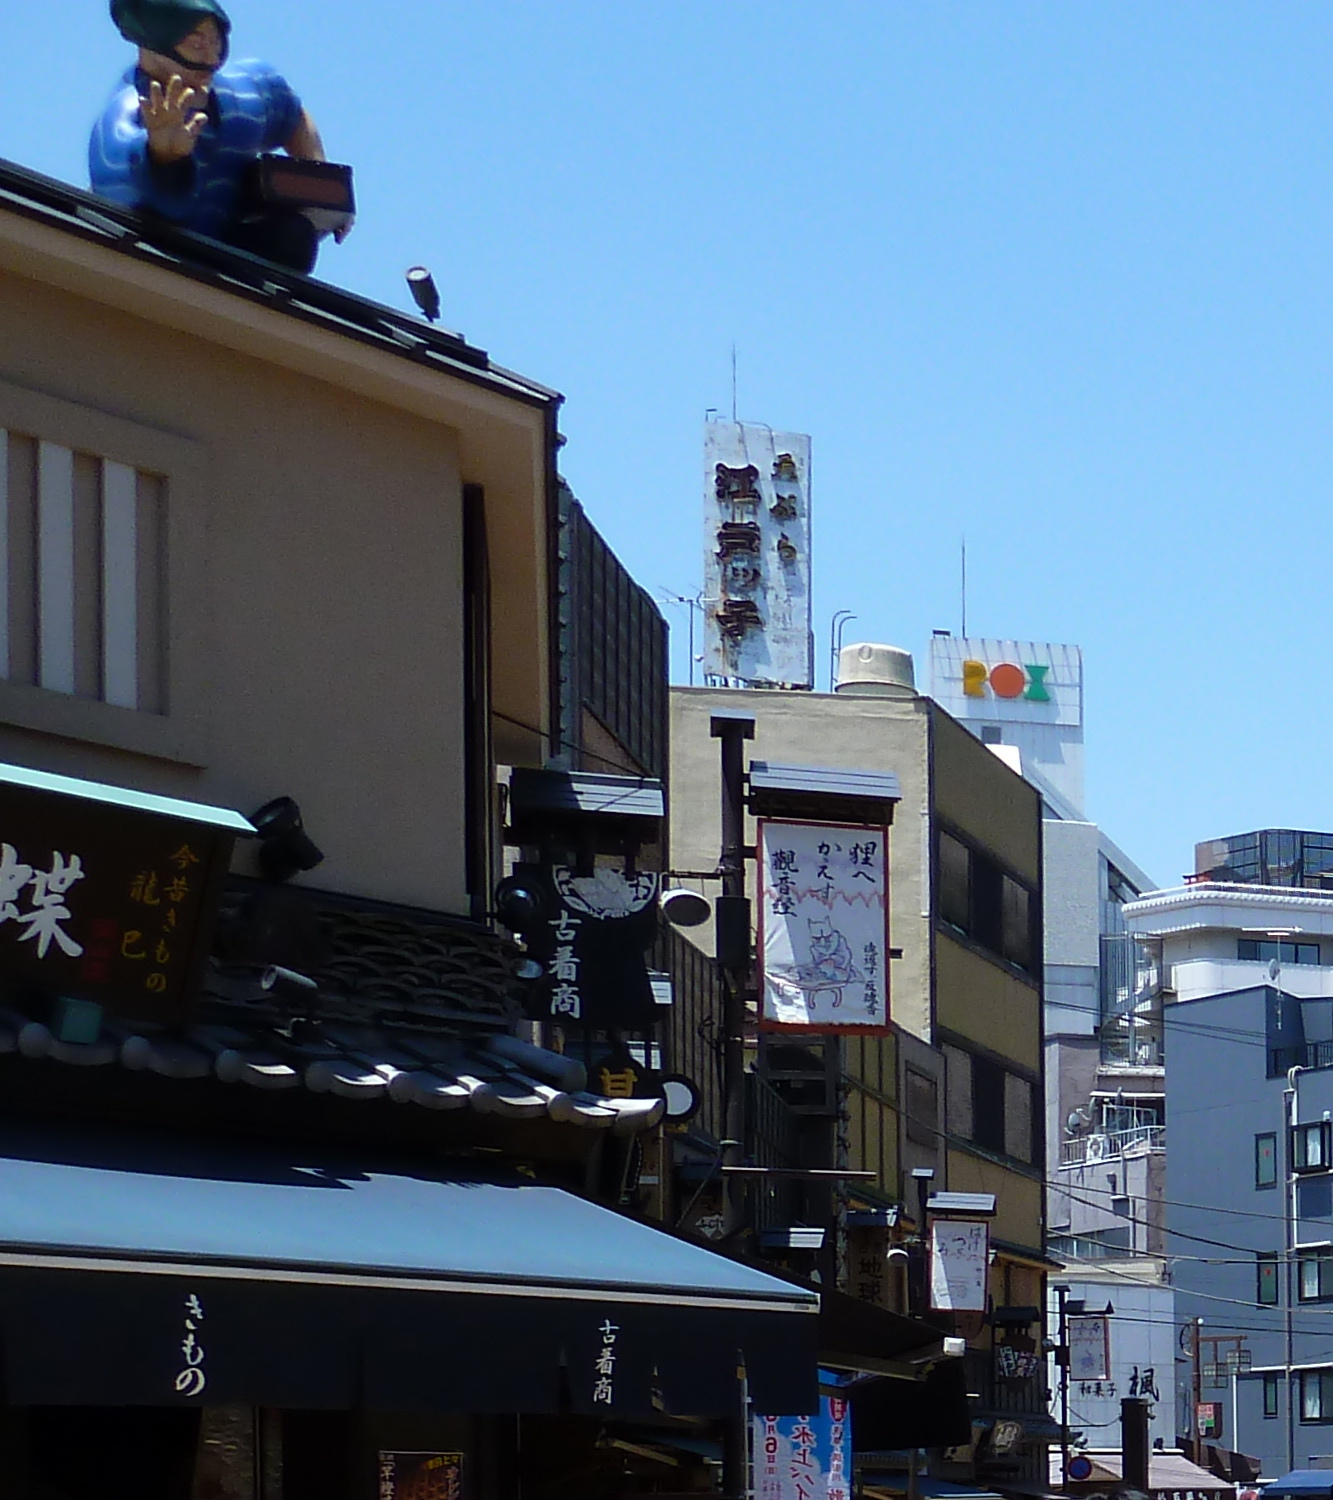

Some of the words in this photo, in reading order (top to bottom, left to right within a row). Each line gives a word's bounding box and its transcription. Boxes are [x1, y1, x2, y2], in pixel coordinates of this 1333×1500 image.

[963, 660, 1050, 702] ROX
[547, 910, 582, 1019] 古着商
[174, 1293, 206, 1398] きもの
[593, 1318, 621, 1405] 古着商
[1079, 1381, 1117, 1398] 和菓子
[1129, 1365, 1160, 1402] 楓
